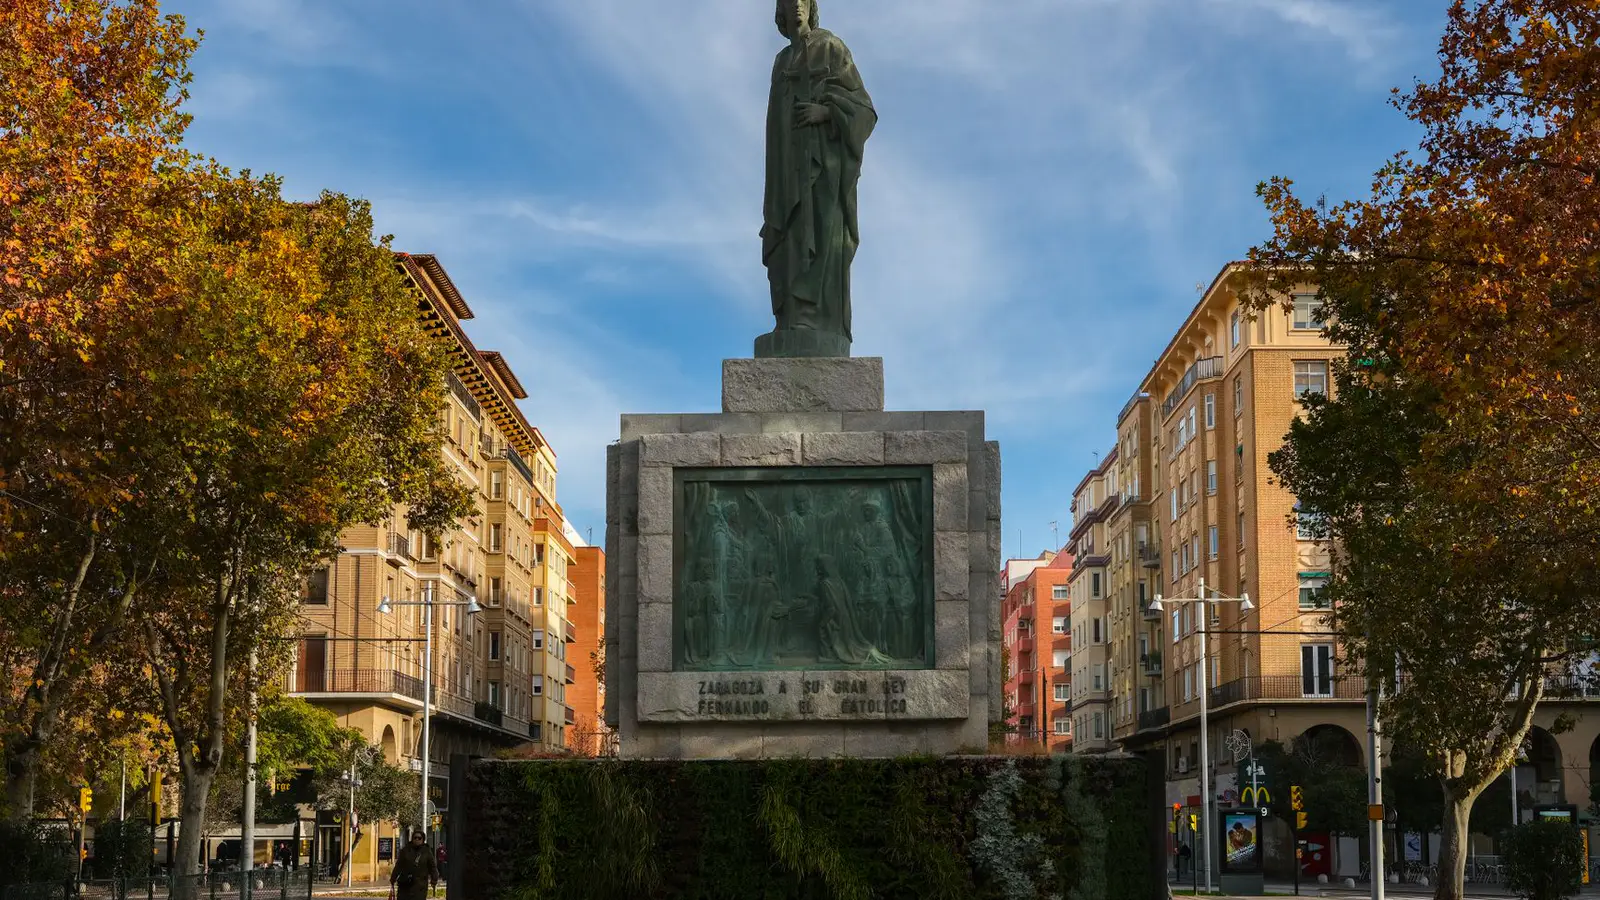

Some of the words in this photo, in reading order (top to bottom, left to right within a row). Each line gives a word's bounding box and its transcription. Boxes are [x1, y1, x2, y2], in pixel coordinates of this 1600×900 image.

[698, 681, 765, 695] ZARAGOZA
[778, 680, 787, 694] A
[803, 679, 821, 694] SU
[834, 680, 868, 694] GRAN
[882, 679, 907, 694] REY
[697, 699, 769, 714] FERNANDO
[799, 699, 814, 714] EL
[841, 699, 907, 714] CATOLICO
